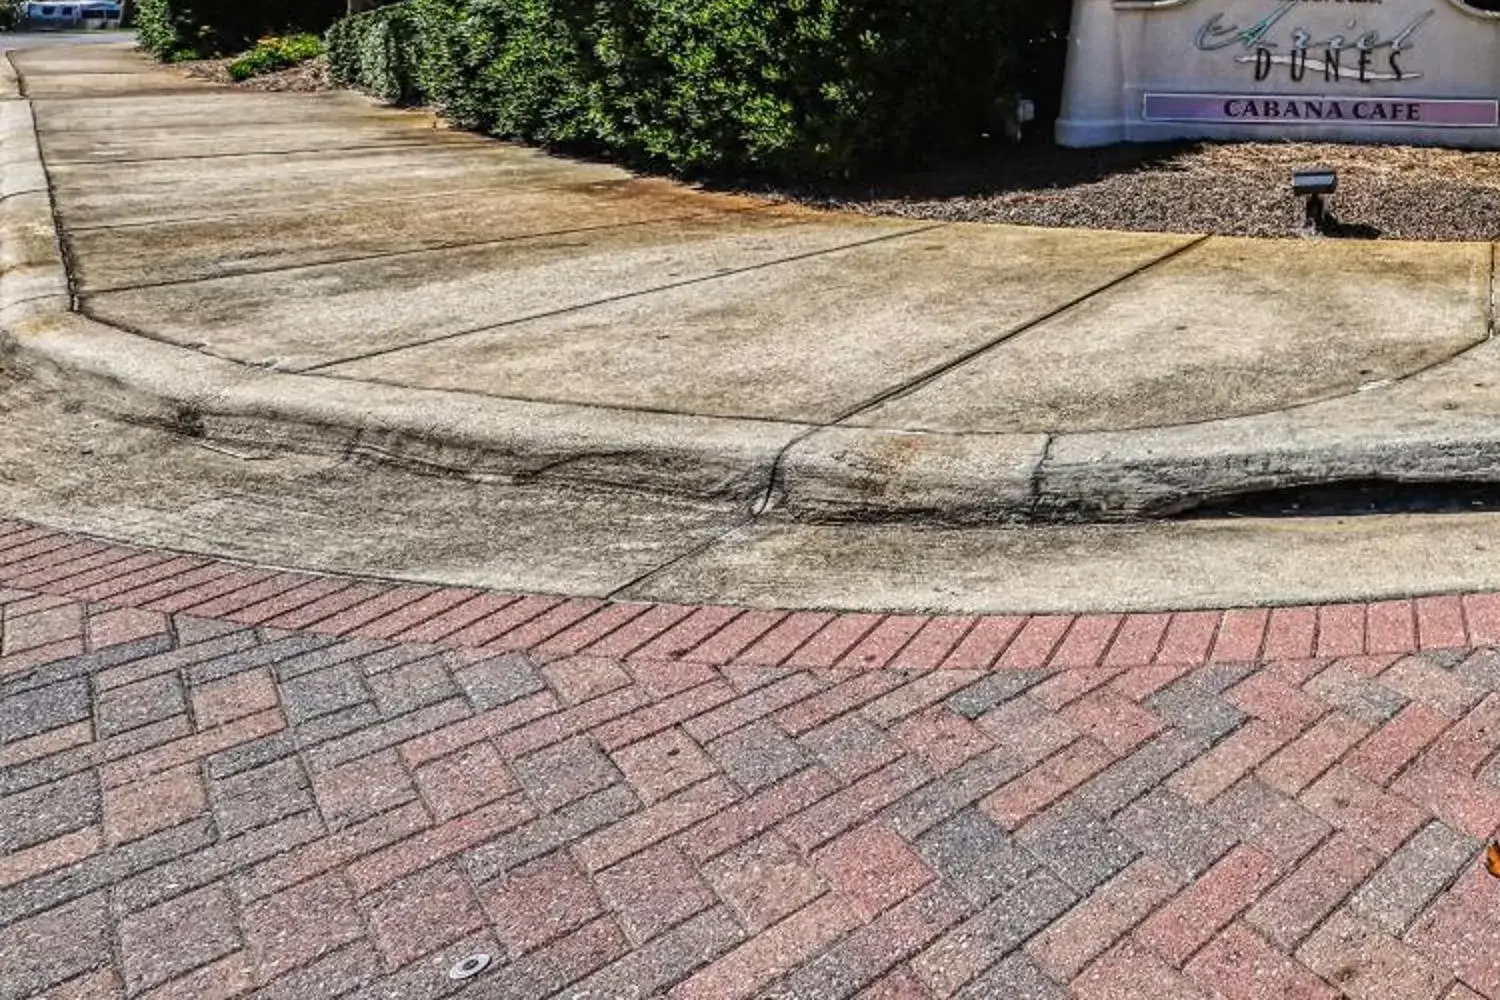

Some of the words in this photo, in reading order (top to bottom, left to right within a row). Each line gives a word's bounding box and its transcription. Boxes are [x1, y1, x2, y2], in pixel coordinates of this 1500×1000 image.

[1254, 47, 1402, 83] DUNES
[1223, 99, 1344, 119] CABANA
[1353, 102, 1422, 122] CAFE
